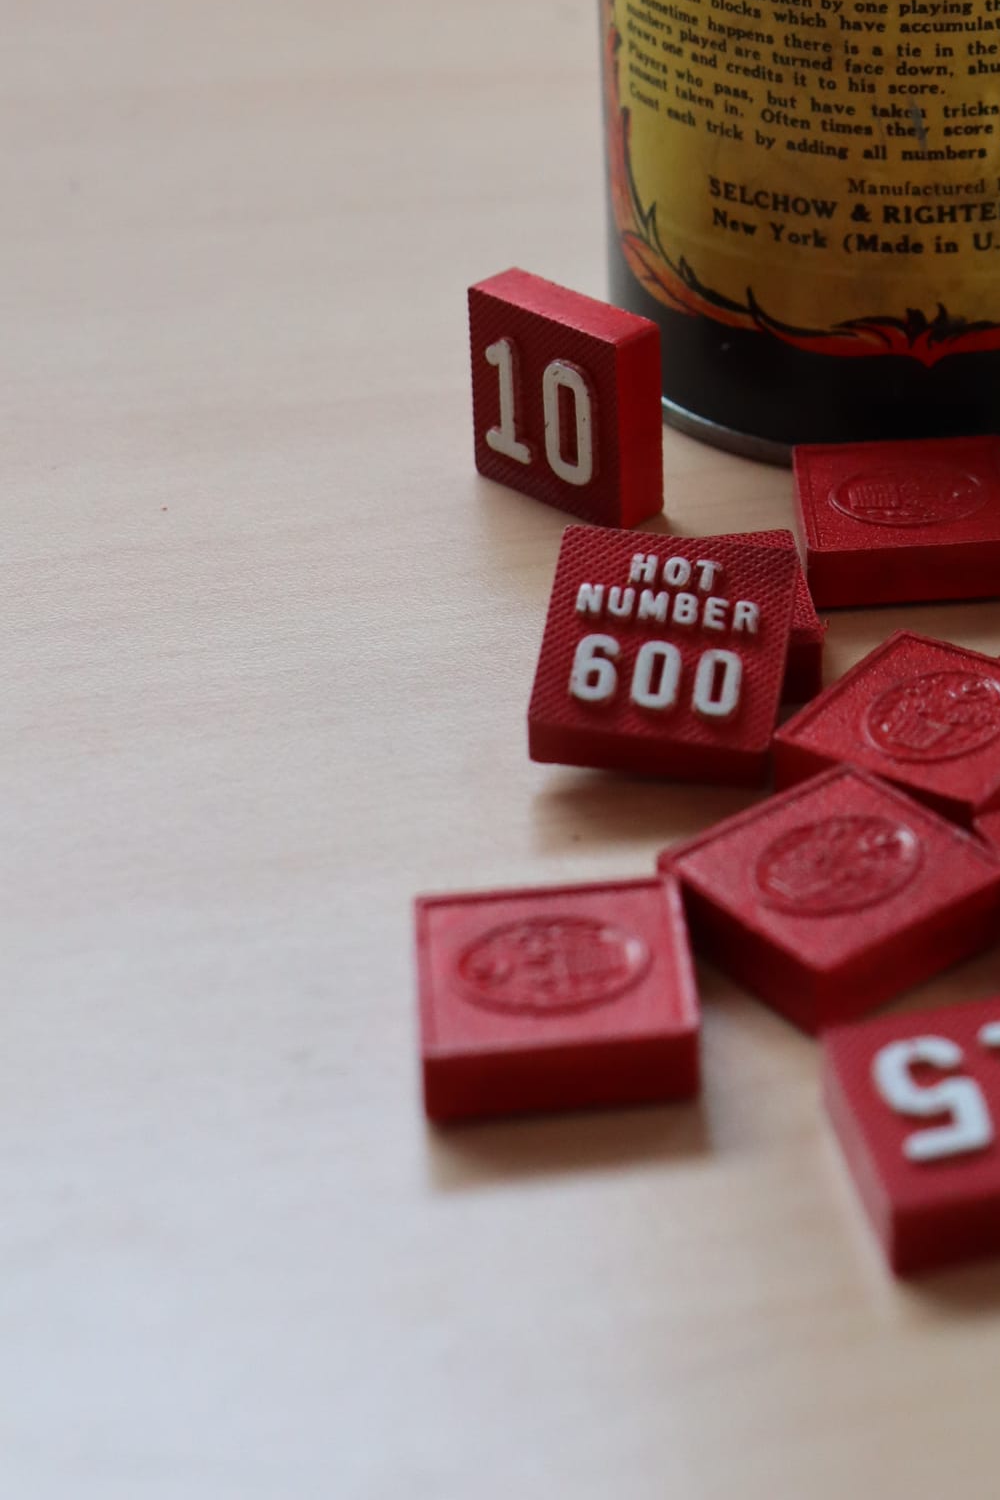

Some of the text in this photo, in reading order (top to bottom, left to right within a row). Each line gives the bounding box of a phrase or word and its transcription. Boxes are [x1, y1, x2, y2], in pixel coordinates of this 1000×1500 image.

[691, 51, 717, 69] and
[726, 62, 783, 84] credits
[793, 71, 807, 87] it
[818, 76, 837, 91] to
[848, 77, 876, 94] his
[888, 84, 945, 95] score.
[710, 177, 837, 218] SELCHOW
[851, 203, 872, 223] &
[847, 178, 986, 197] Manufactured
[713, 207, 757, 236] New
[769, 222, 827, 248] York
[843, 233, 924, 254] (Made
[935, 235, 959, 254] in
[973, 231, 1000, 251] U.
[485, 339, 592, 485] 10
[629, 553, 722, 591] HOT
[575, 582, 760, 633] NUMBER
[569, 634, 742, 716] 600
